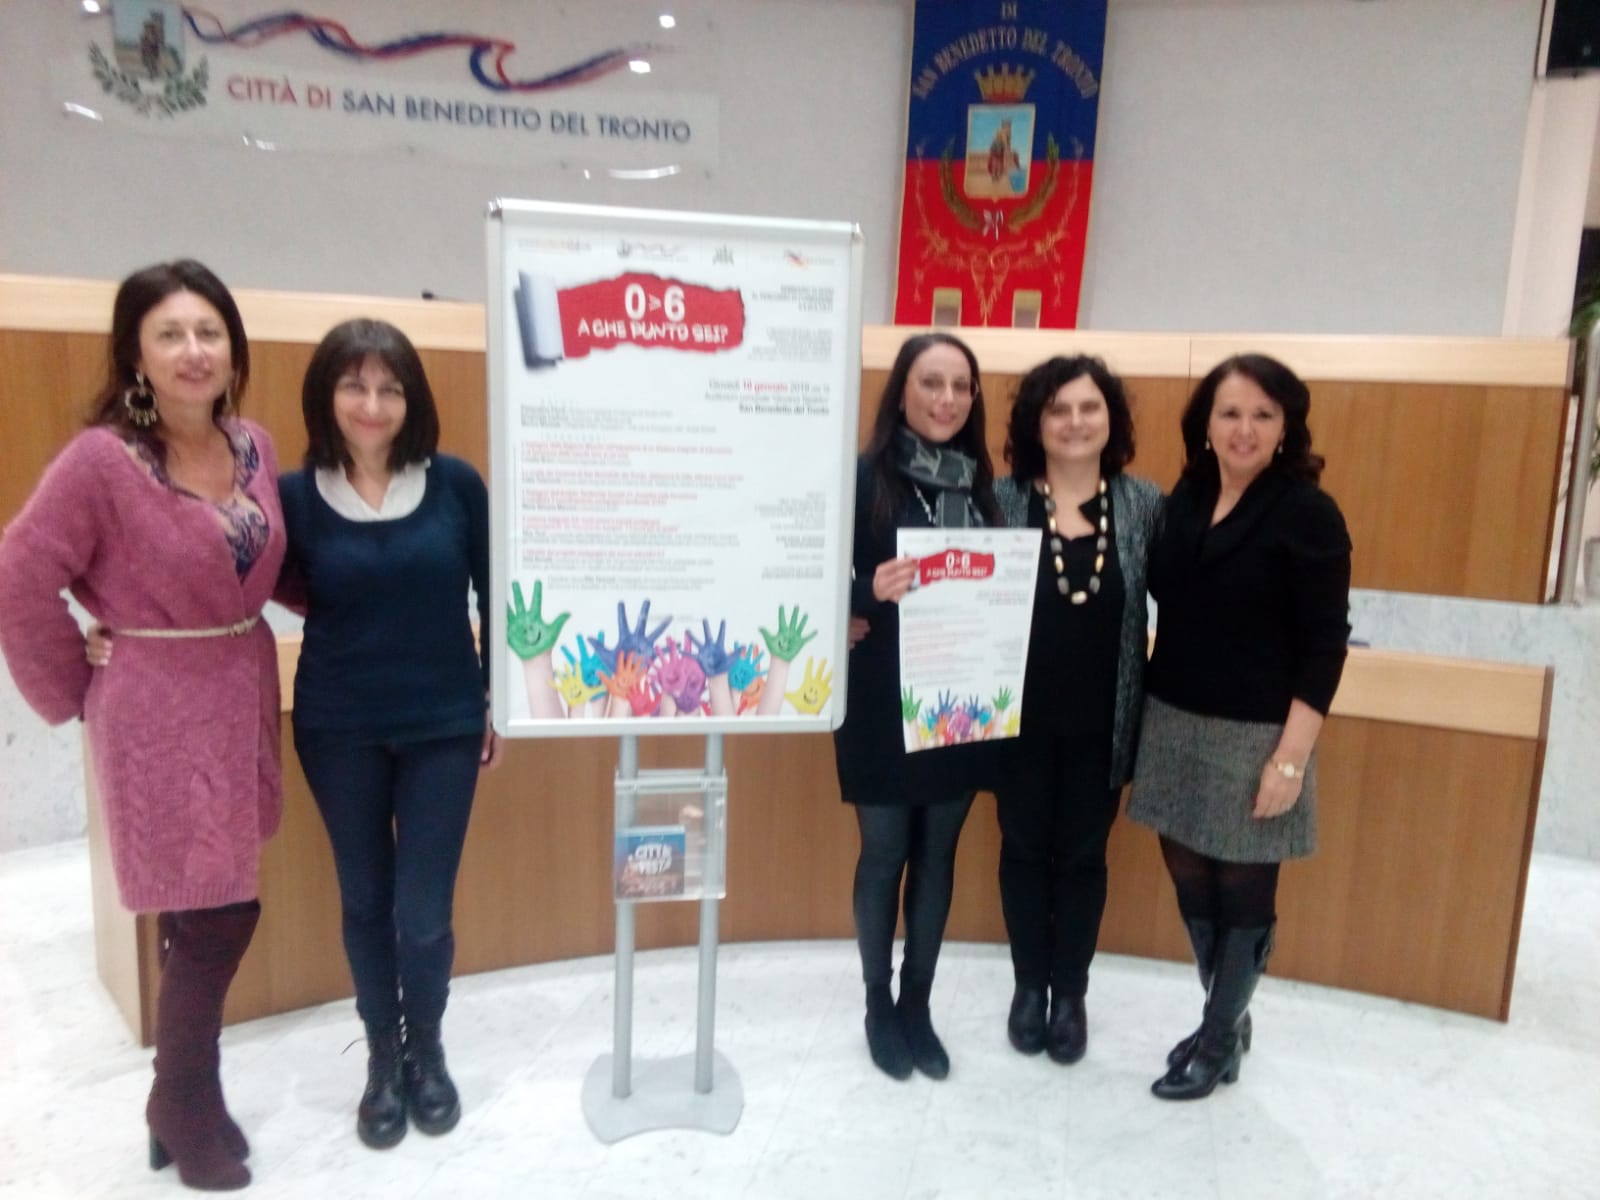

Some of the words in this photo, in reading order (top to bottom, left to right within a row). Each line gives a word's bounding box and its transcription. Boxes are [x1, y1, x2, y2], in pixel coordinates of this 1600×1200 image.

[933, 26, 1017, 75] BENEDETTO
[227, 74, 298, 106] CITTÀ
[306, 83, 331, 111] DI
[342, 88, 396, 118] SAN
[405, 95, 541, 132] BENEDETTO
[549, 109, 589, 137] DEL
[597, 113, 691, 144] TRONTO
[578, 317, 590, 336] A
[592, 319, 627, 339] CHE
[629, 321, 688, 341] PUNTO
